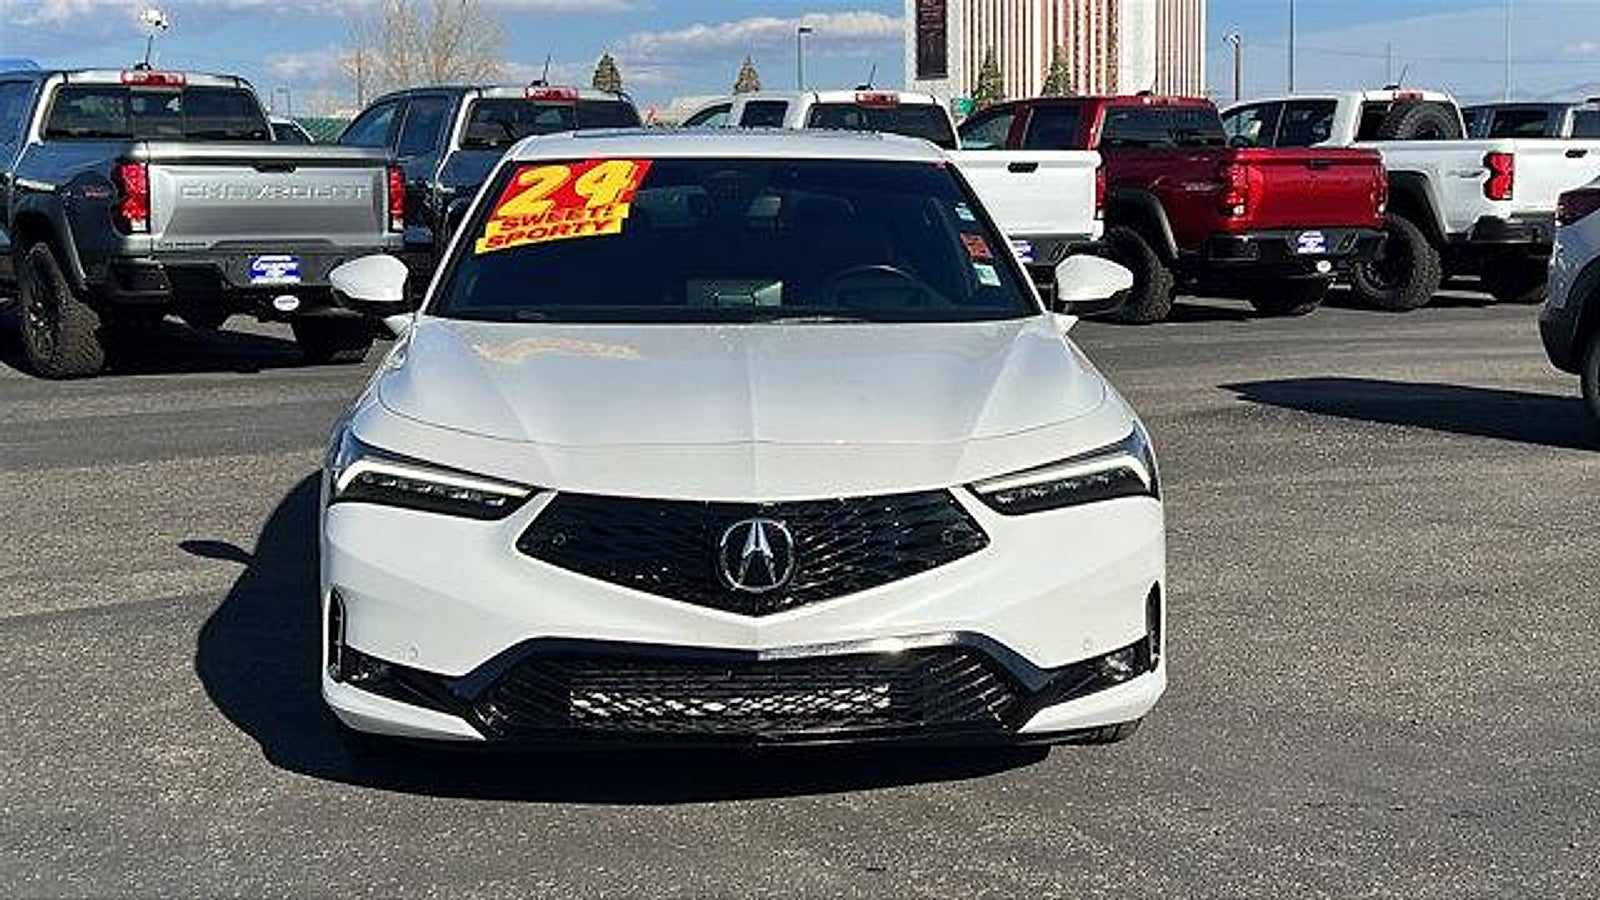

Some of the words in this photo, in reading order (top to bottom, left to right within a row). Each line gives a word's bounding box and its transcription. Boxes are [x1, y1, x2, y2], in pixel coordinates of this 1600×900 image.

[180, 184, 367, 199] CHEVROLET
[497, 159, 637, 216] 24
[484, 218, 611, 249] SPORTY
